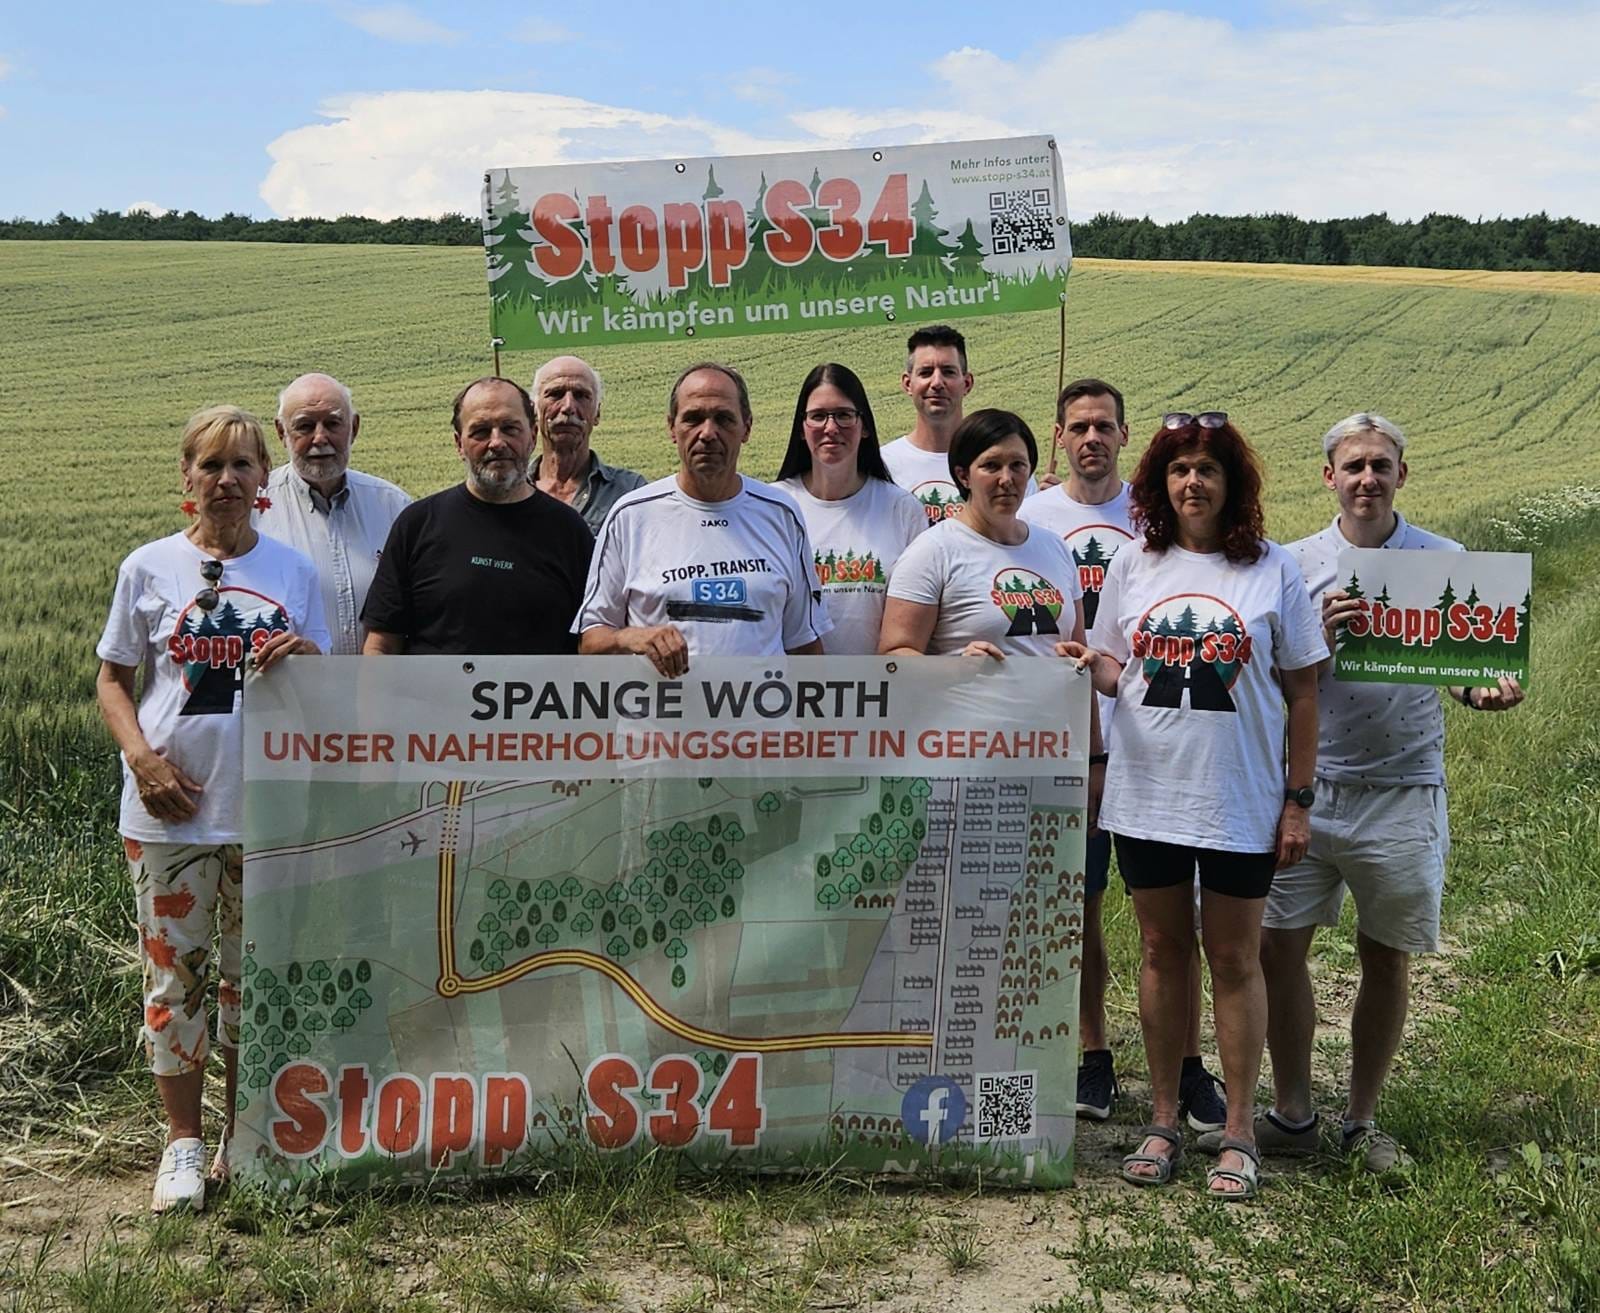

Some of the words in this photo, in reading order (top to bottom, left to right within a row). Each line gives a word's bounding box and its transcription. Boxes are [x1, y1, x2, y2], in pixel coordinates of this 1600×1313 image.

[950, 159, 981, 170] Mehr
[984, 156, 1011, 168] Infos
[1015, 155, 1050, 165] unter:
[951, 168, 1051, 184] www.stopp-s34.at
[531, 193, 748, 288] Stopp
[765, 174, 915, 266] S34
[538, 311, 593, 335] Wir
[604, 299, 734, 334] kämpfen
[745, 302, 789, 323] um
[799, 294, 896, 319] unsere
[905, 279, 1000, 310] Natur!
[662, 565, 709, 584] STOPP.
[711, 559, 772, 576] TRANSIT.
[836, 560, 875, 580] S34
[991, 590, 1033, 608] Stopp
[1033, 589, 1064, 605] S34
[1347, 601, 1442, 647] Stopp
[1448, 603, 1518, 643] S34
[167, 634, 243, 667] Stopp
[1132, 630, 1194, 667] Stopp
[1201, 632, 1253, 665] S34
[1340, 661, 1361, 671] Wir
[1364, 662, 1415, 675] kämpfen
[1418, 667, 1437, 675] um
[1440, 667, 1480, 677] unsere
[1483, 667, 1523, 679] Natur!
[470, 680, 683, 720] SPANGE
[701, 670, 889, 718] WÖRTH
[264, 731, 395, 762] UNSER
[407, 731, 859, 762] NAHERHOLUNGSGEBIET
[868, 730, 905, 757] IN
[917, 730, 1069, 758] GEFAHR!
[270, 1061, 530, 1167] Stopp
[584, 1054, 764, 1148] S34
